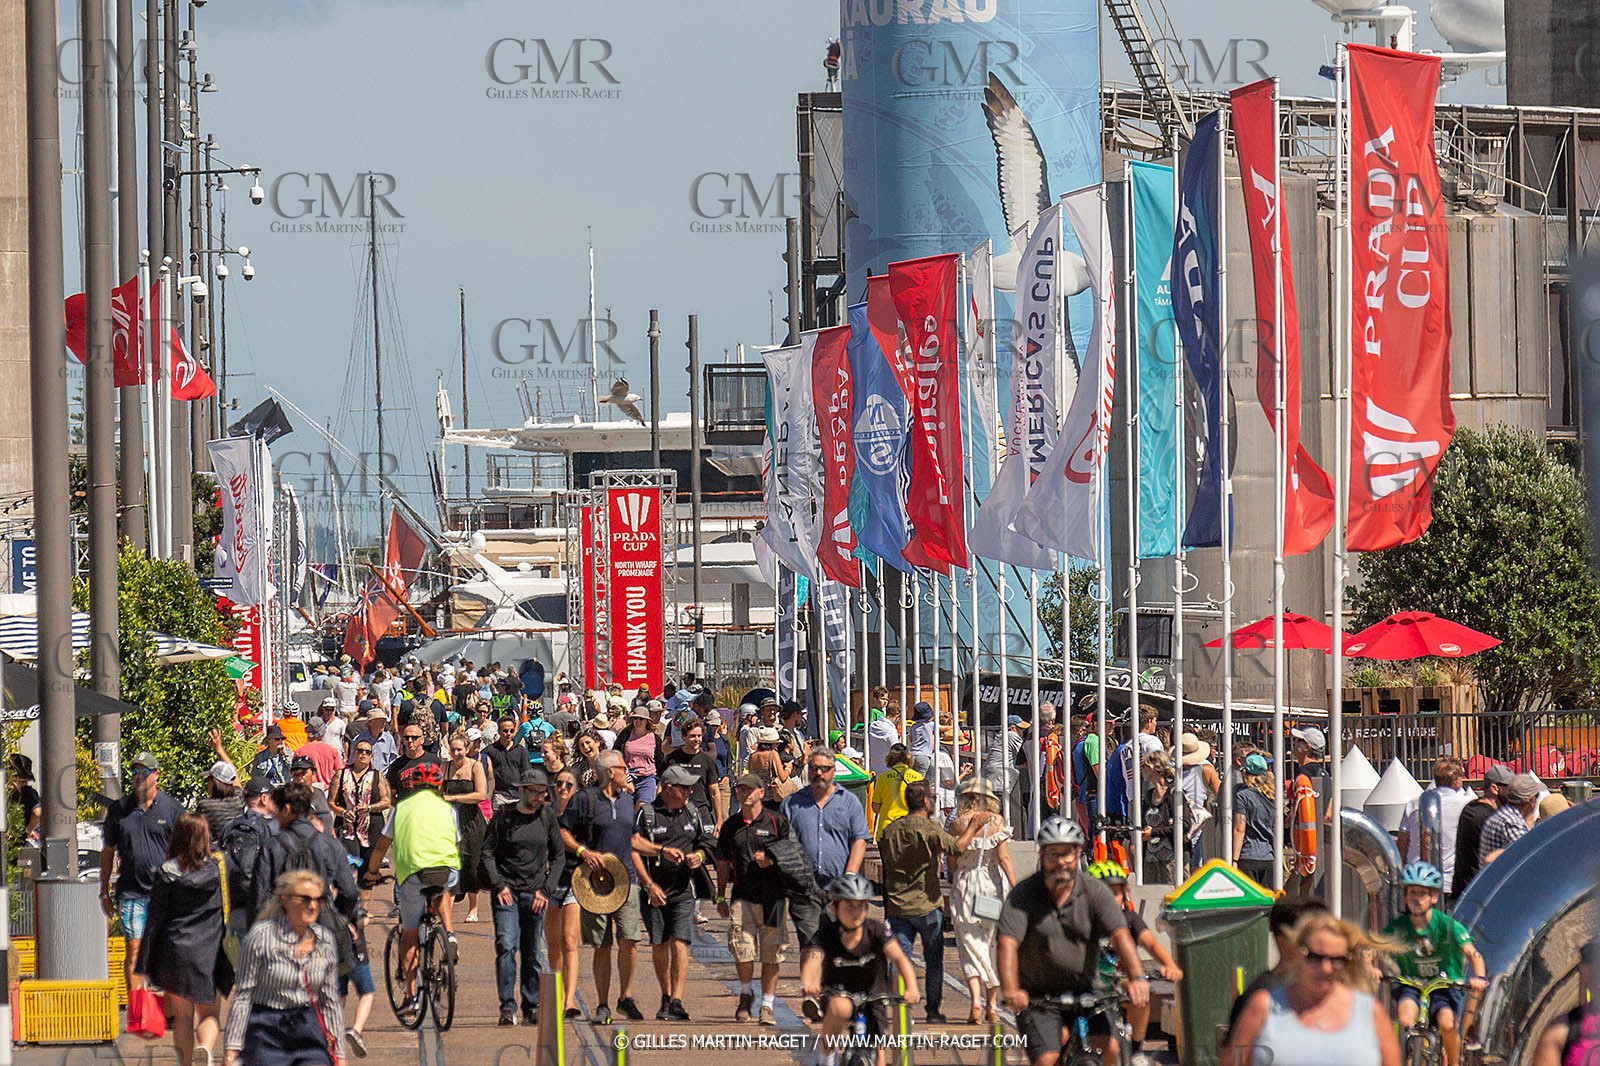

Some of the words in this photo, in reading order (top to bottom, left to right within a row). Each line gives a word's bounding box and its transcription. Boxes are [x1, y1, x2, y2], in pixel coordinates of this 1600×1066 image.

[1364, 124, 1399, 358] PRADA
[1397, 177, 1430, 310] CUP
[613, 532, 657, 542] PRADA
[623, 542, 648, 552] CUP
[614, 561, 635, 569] NORTH
[635, 560, 658, 569] WHARF
[617, 569, 655, 577] PROMENADE
[626, 586, 647, 618] YOU
[626, 624, 647, 682] THANK
[978, 684, 1001, 703] SEA
[1006, 687, 1077, 707] CLEANERS
[1354, 727, 1402, 738] RECYCE
